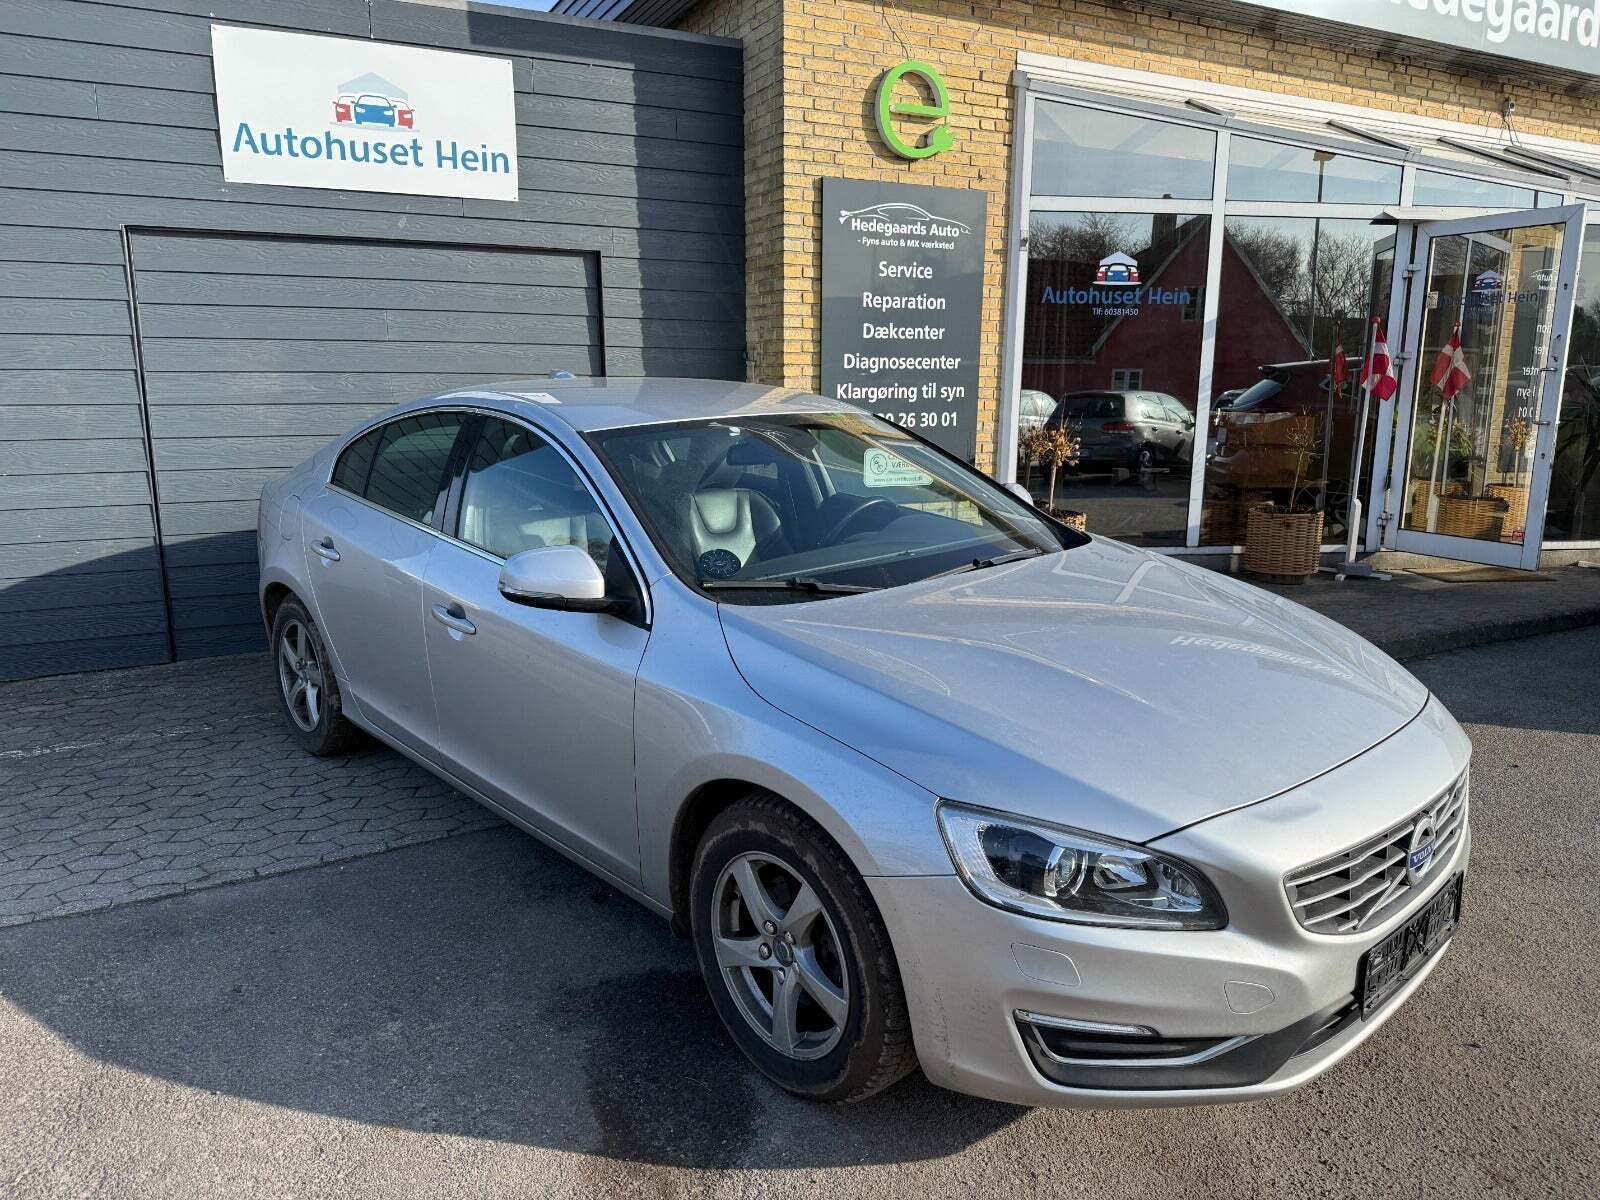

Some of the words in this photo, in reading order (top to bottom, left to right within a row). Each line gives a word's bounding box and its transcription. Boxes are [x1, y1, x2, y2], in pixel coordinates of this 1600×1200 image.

[232, 122, 424, 168] Autohuset
[435, 139, 511, 174] Hein
[851, 218, 927, 237] Hedegaards
[929, 223, 960, 238] Auto
[862, 236, 880, 247] Fyns
[880, 238, 899, 247] auto
[900, 239, 906, 247] &
[907, 239, 920, 248] MX
[920, 240, 955, 250] værksted
[879, 260, 933, 279] Service
[862, 291, 946, 312] Reparation
[1041, 286, 1143, 305] Autohuset
[1148, 286, 1191, 305] Hein
[1104, 308, 1139, 316] 60381450
[862, 322, 946, 340] Dækcenter
[843, 352, 962, 373] Diagnosecenter
[836, 382, 918, 403] Klargøring
[921, 382, 938, 399] til
[940, 385, 966, 402] syn
[898, 412, 916, 428] 26
[920, 412, 938, 427] 30
[941, 411, 957, 427] 01
